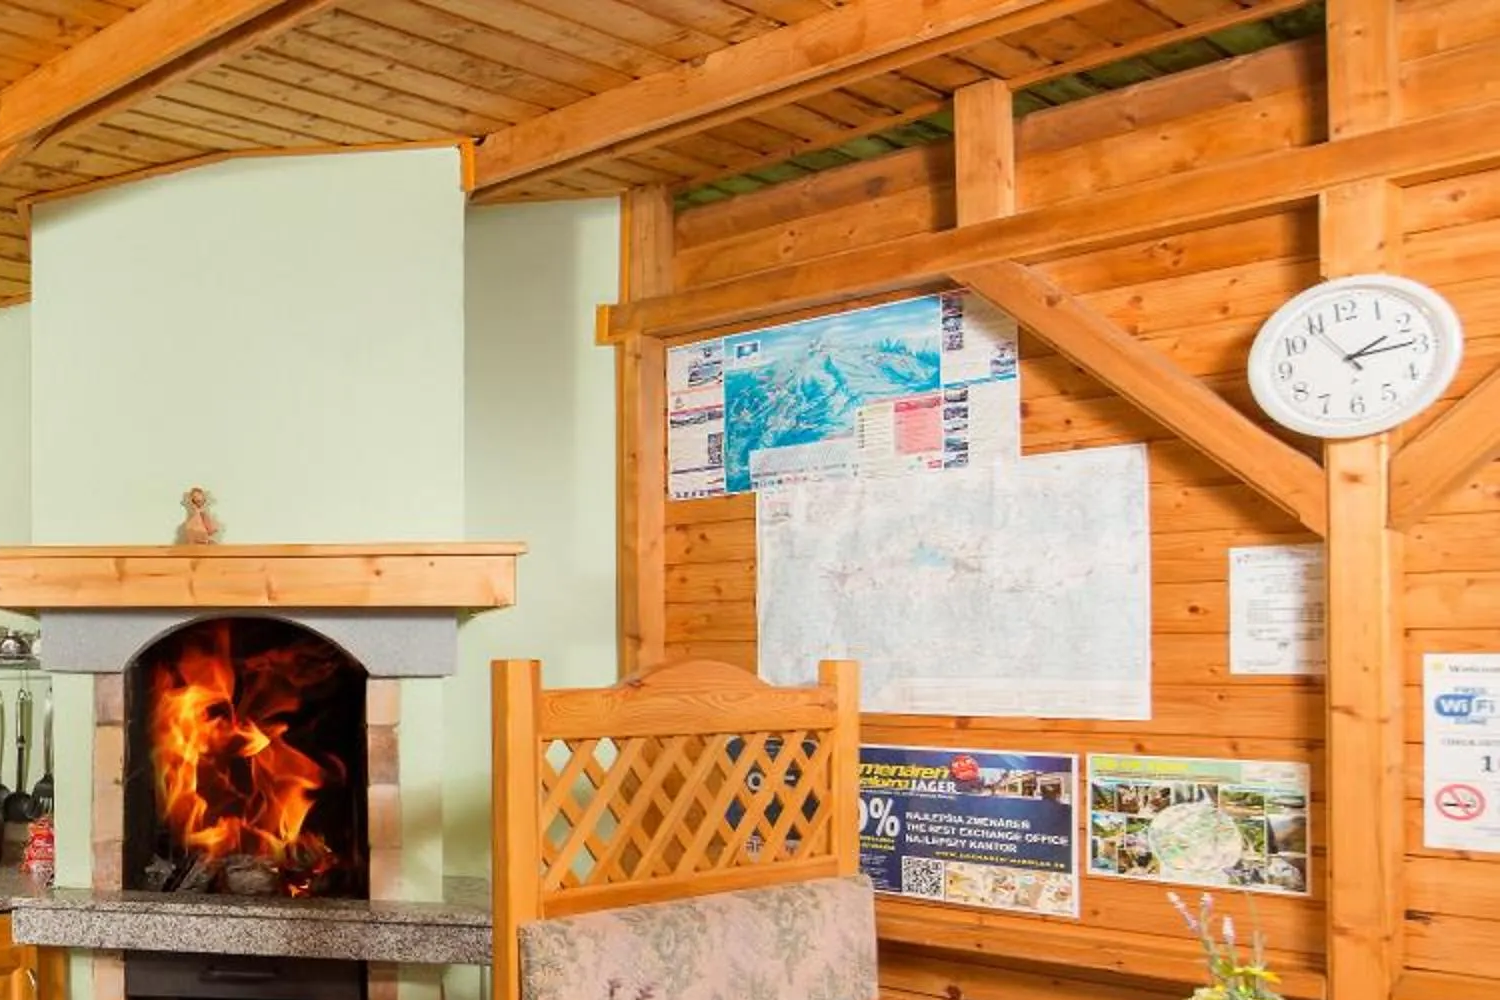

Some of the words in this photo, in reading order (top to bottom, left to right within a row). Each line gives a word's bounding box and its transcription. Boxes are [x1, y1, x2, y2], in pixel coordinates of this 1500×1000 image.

[1332, 299, 1357, 322] 12
[1374, 299, 1382, 320] 1
[1307, 313, 1324, 335] 11
[1396, 313, 1411, 333] 2
[1284, 335, 1307, 356] 10
[1412, 333, 1429, 353] 3
[1278, 361, 1293, 379] 9
[1406, 361, 1419, 380] 4
[1292, 381, 1309, 401] 8
[1381, 383, 1396, 401] 5
[1318, 393, 1331, 414] 7
[1350, 396, 1365, 414] 6
[906, 822, 927, 833] THE
[959, 827, 1022, 841] EXCHANGE
[1025, 834, 1069, 846] OFFICE
[969, 839, 1018, 853] KANTOR
